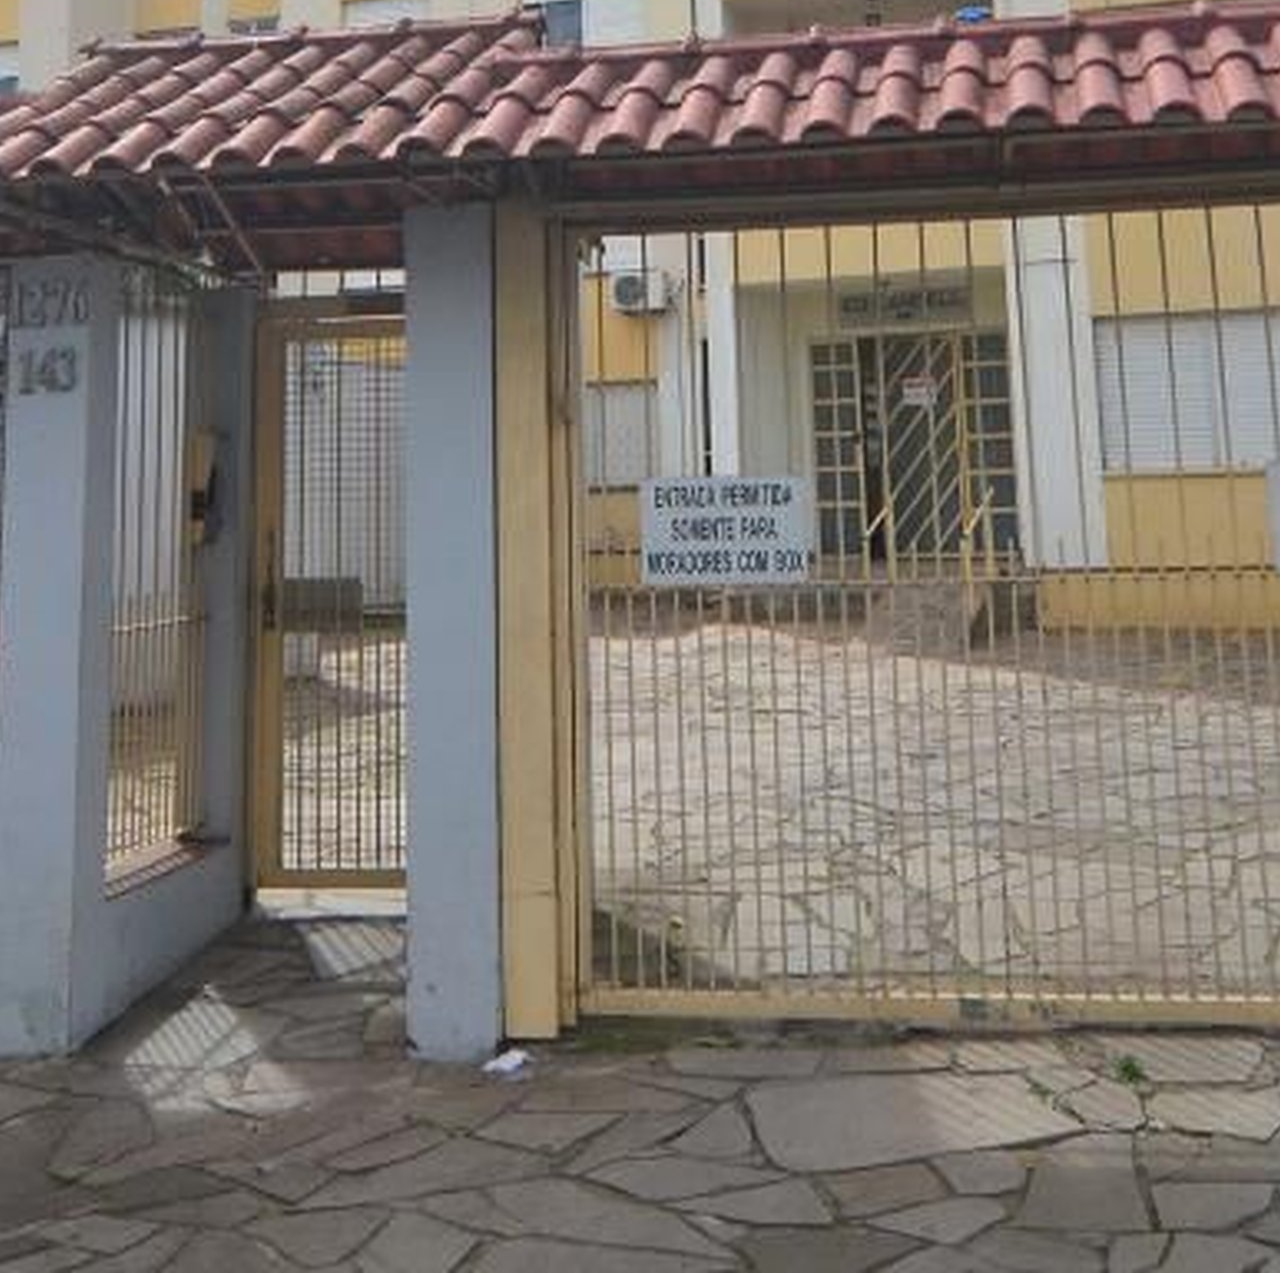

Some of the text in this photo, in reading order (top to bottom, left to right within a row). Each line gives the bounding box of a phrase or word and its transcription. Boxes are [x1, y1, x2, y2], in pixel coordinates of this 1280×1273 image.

[18, 346, 77, 395] 143
[653, 483, 792, 509] ENTRADA PERMITIDA
[670, 515, 779, 542] SOMENTE PARA
[647, 550, 732, 575] MORADORES
[737, 549, 768, 573] COM
